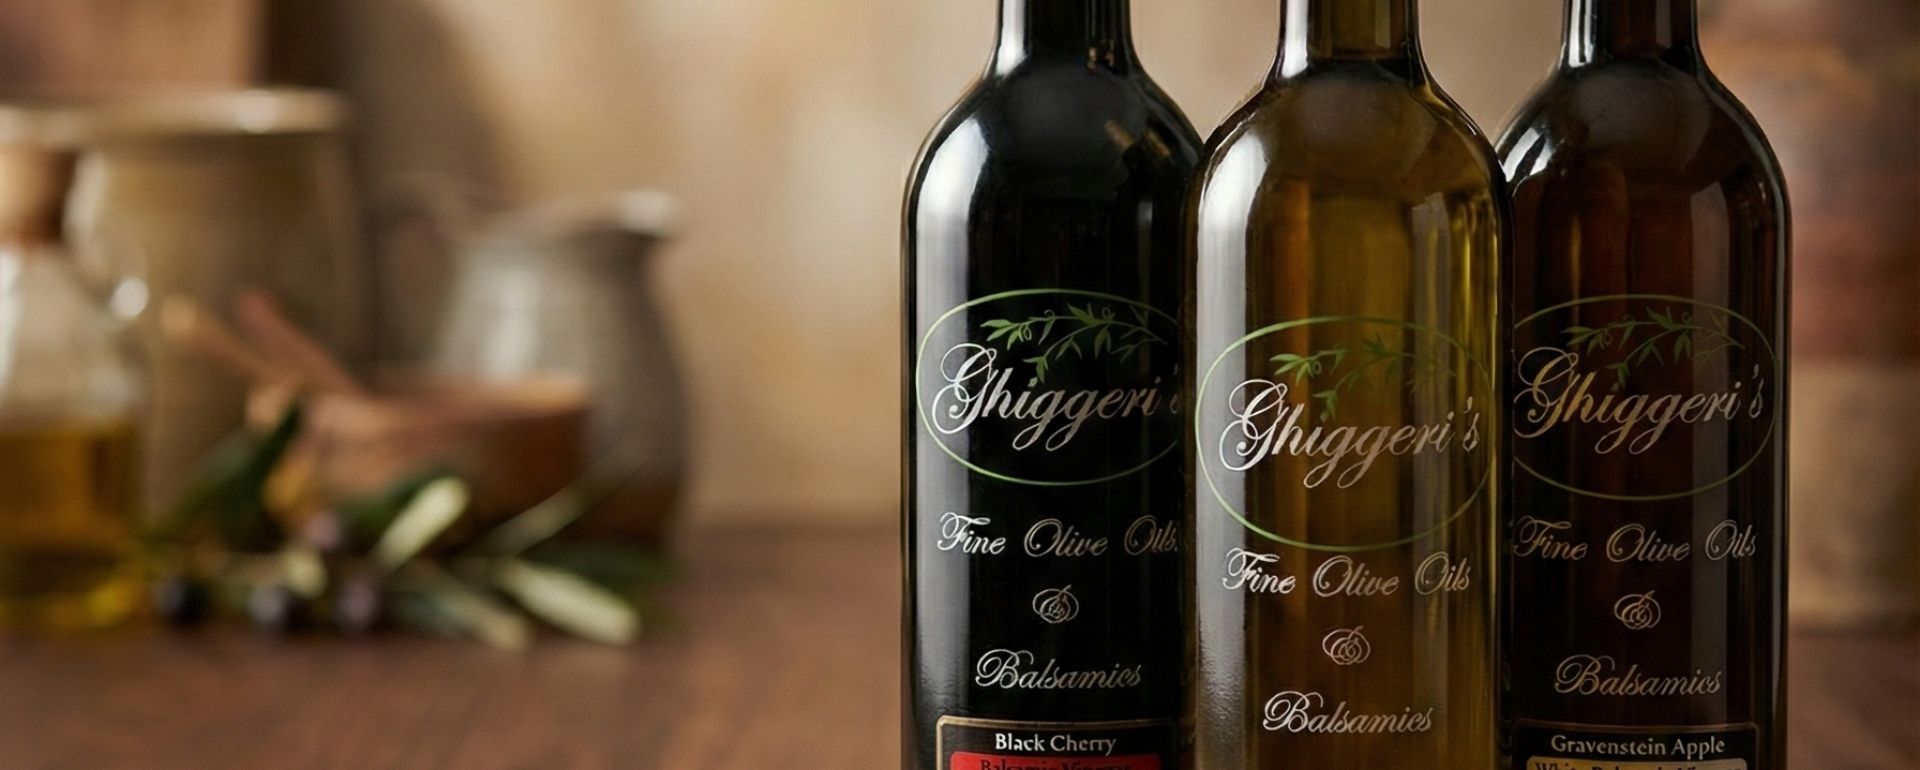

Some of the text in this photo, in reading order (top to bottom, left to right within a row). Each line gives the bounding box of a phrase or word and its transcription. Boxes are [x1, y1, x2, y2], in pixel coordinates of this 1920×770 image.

[1513, 346, 1764, 455] Ghiggeri's
[1218, 379, 1481, 488] Ghiggeri's
[936, 511, 1007, 555] Fine
[1023, 517, 1108, 558] Olive
[1513, 515, 1758, 563] Fine Olive Oils
[1221, 547, 1472, 598] Fine Olive Oils
[975, 648, 1142, 690] Balsamics
[1554, 654, 1722, 696] Balsamics
[994, 732, 1117, 756] Black Cherry
[1550, 735, 1726, 760] Gravenstein Apple
